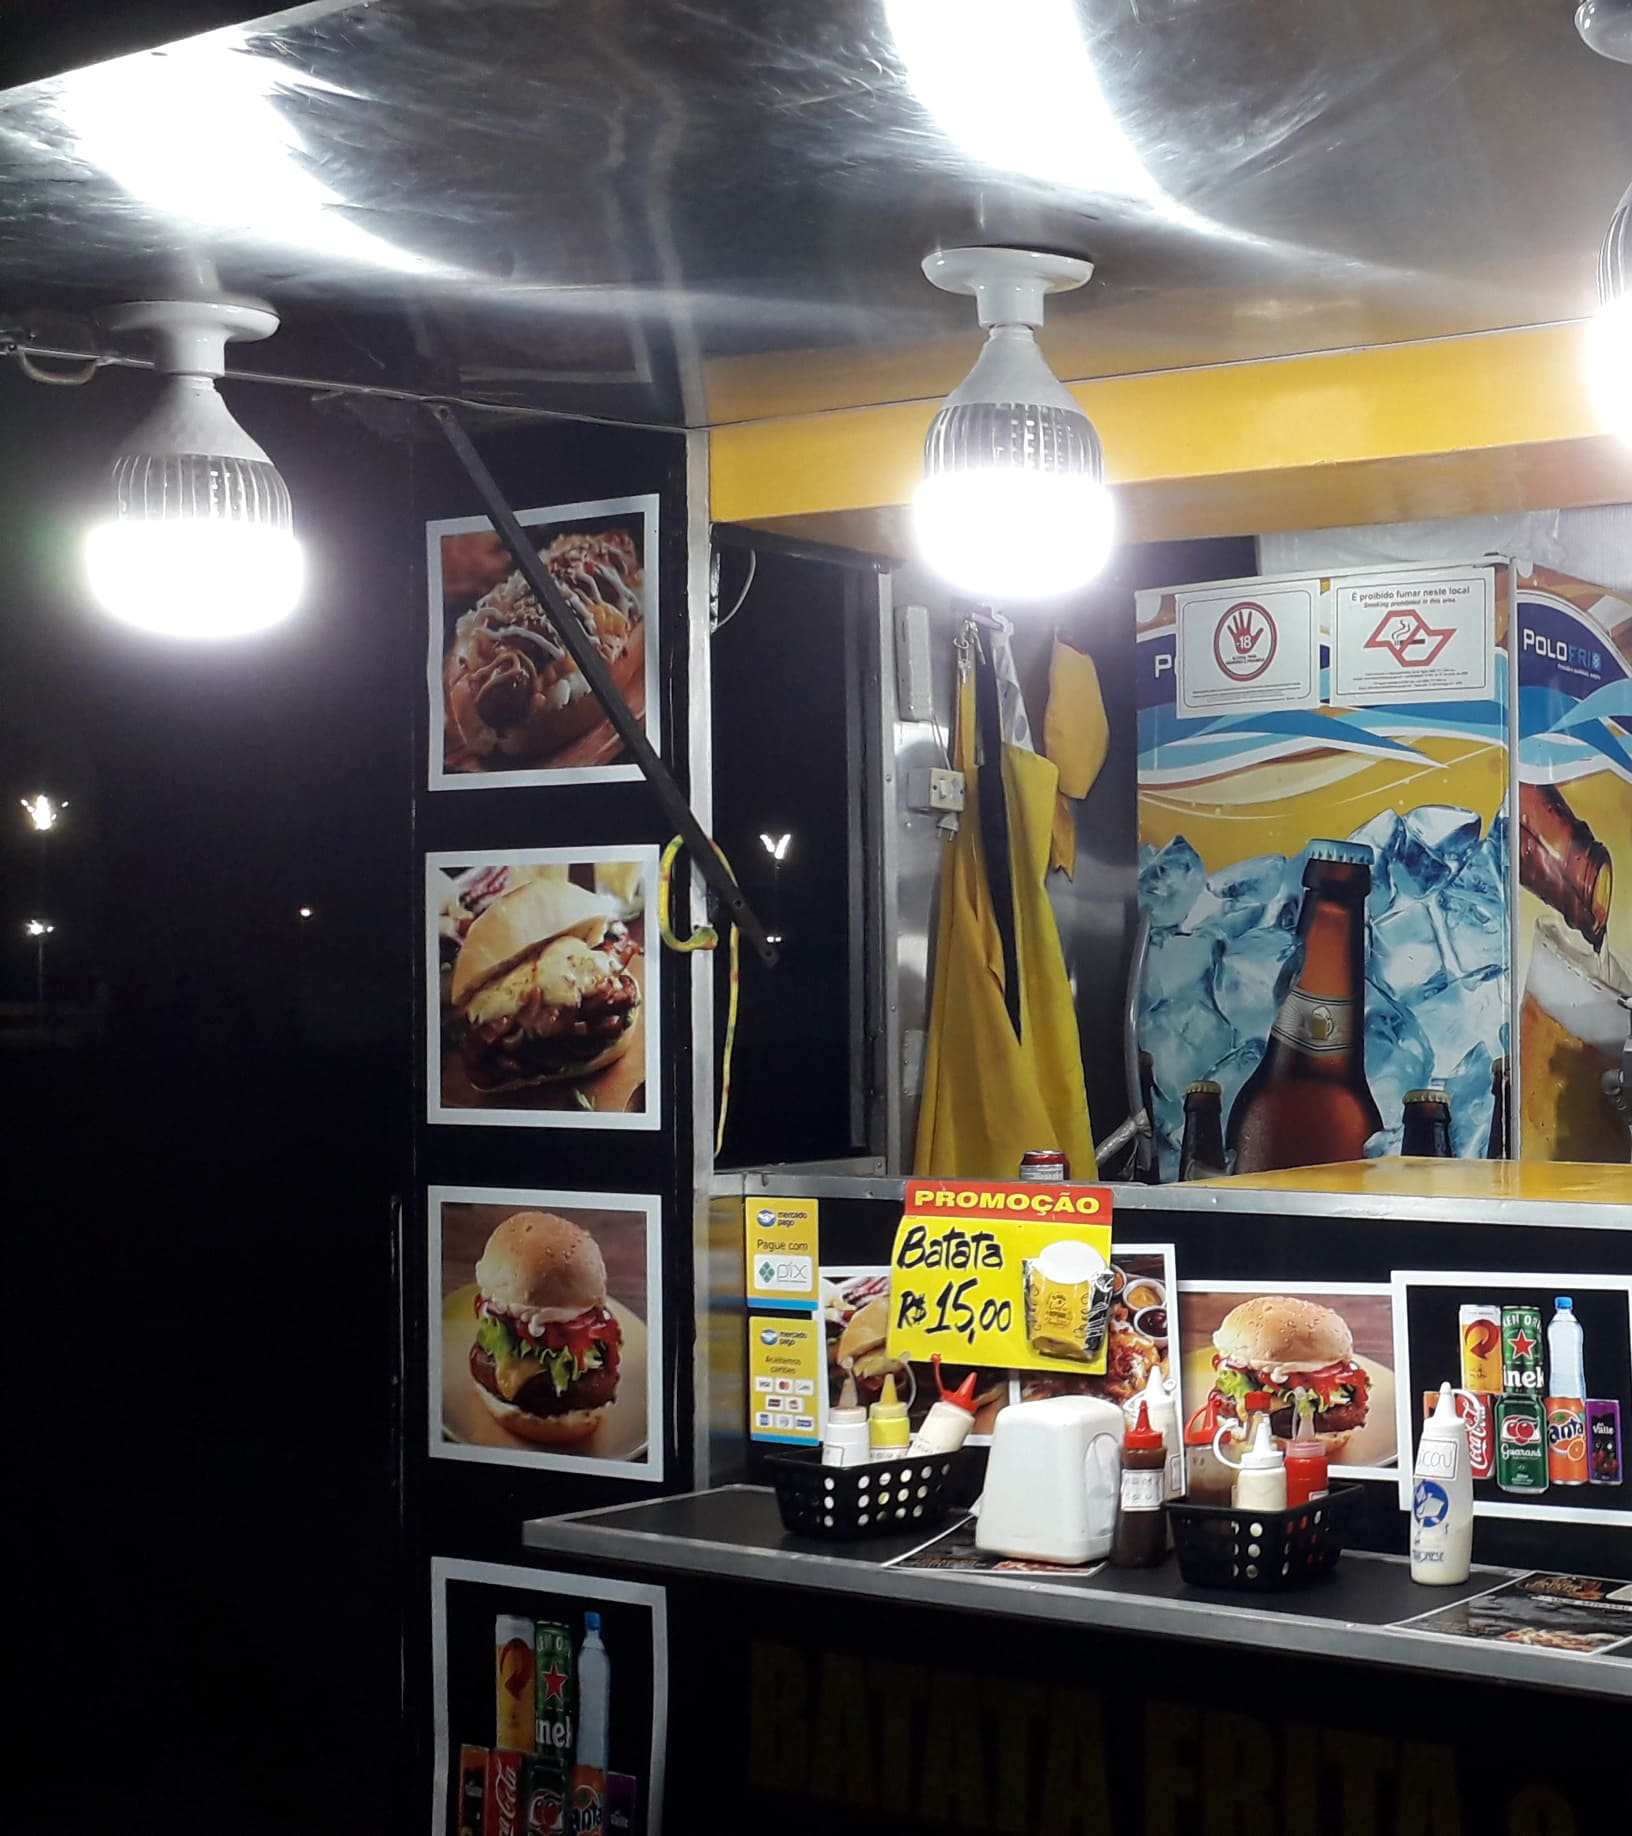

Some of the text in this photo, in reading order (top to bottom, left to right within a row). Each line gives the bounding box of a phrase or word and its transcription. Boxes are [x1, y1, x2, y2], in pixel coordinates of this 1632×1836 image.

[1360, 590, 1395, 603] proibido
[1397, 589, 1422, 599] fumar
[1423, 587, 1447, 597] neste
[1449, 585, 1471, 595] local
[914, 1190, 1101, 1216] PROMOÇÃO
[777, 1211, 808, 1220] mercado
[777, 1219, 796, 1228] pago
[757, 1239, 809, 1252] Pague com
[896, 1225, 1004, 1271] Batata
[1550, 1418, 1584, 1443] anta
